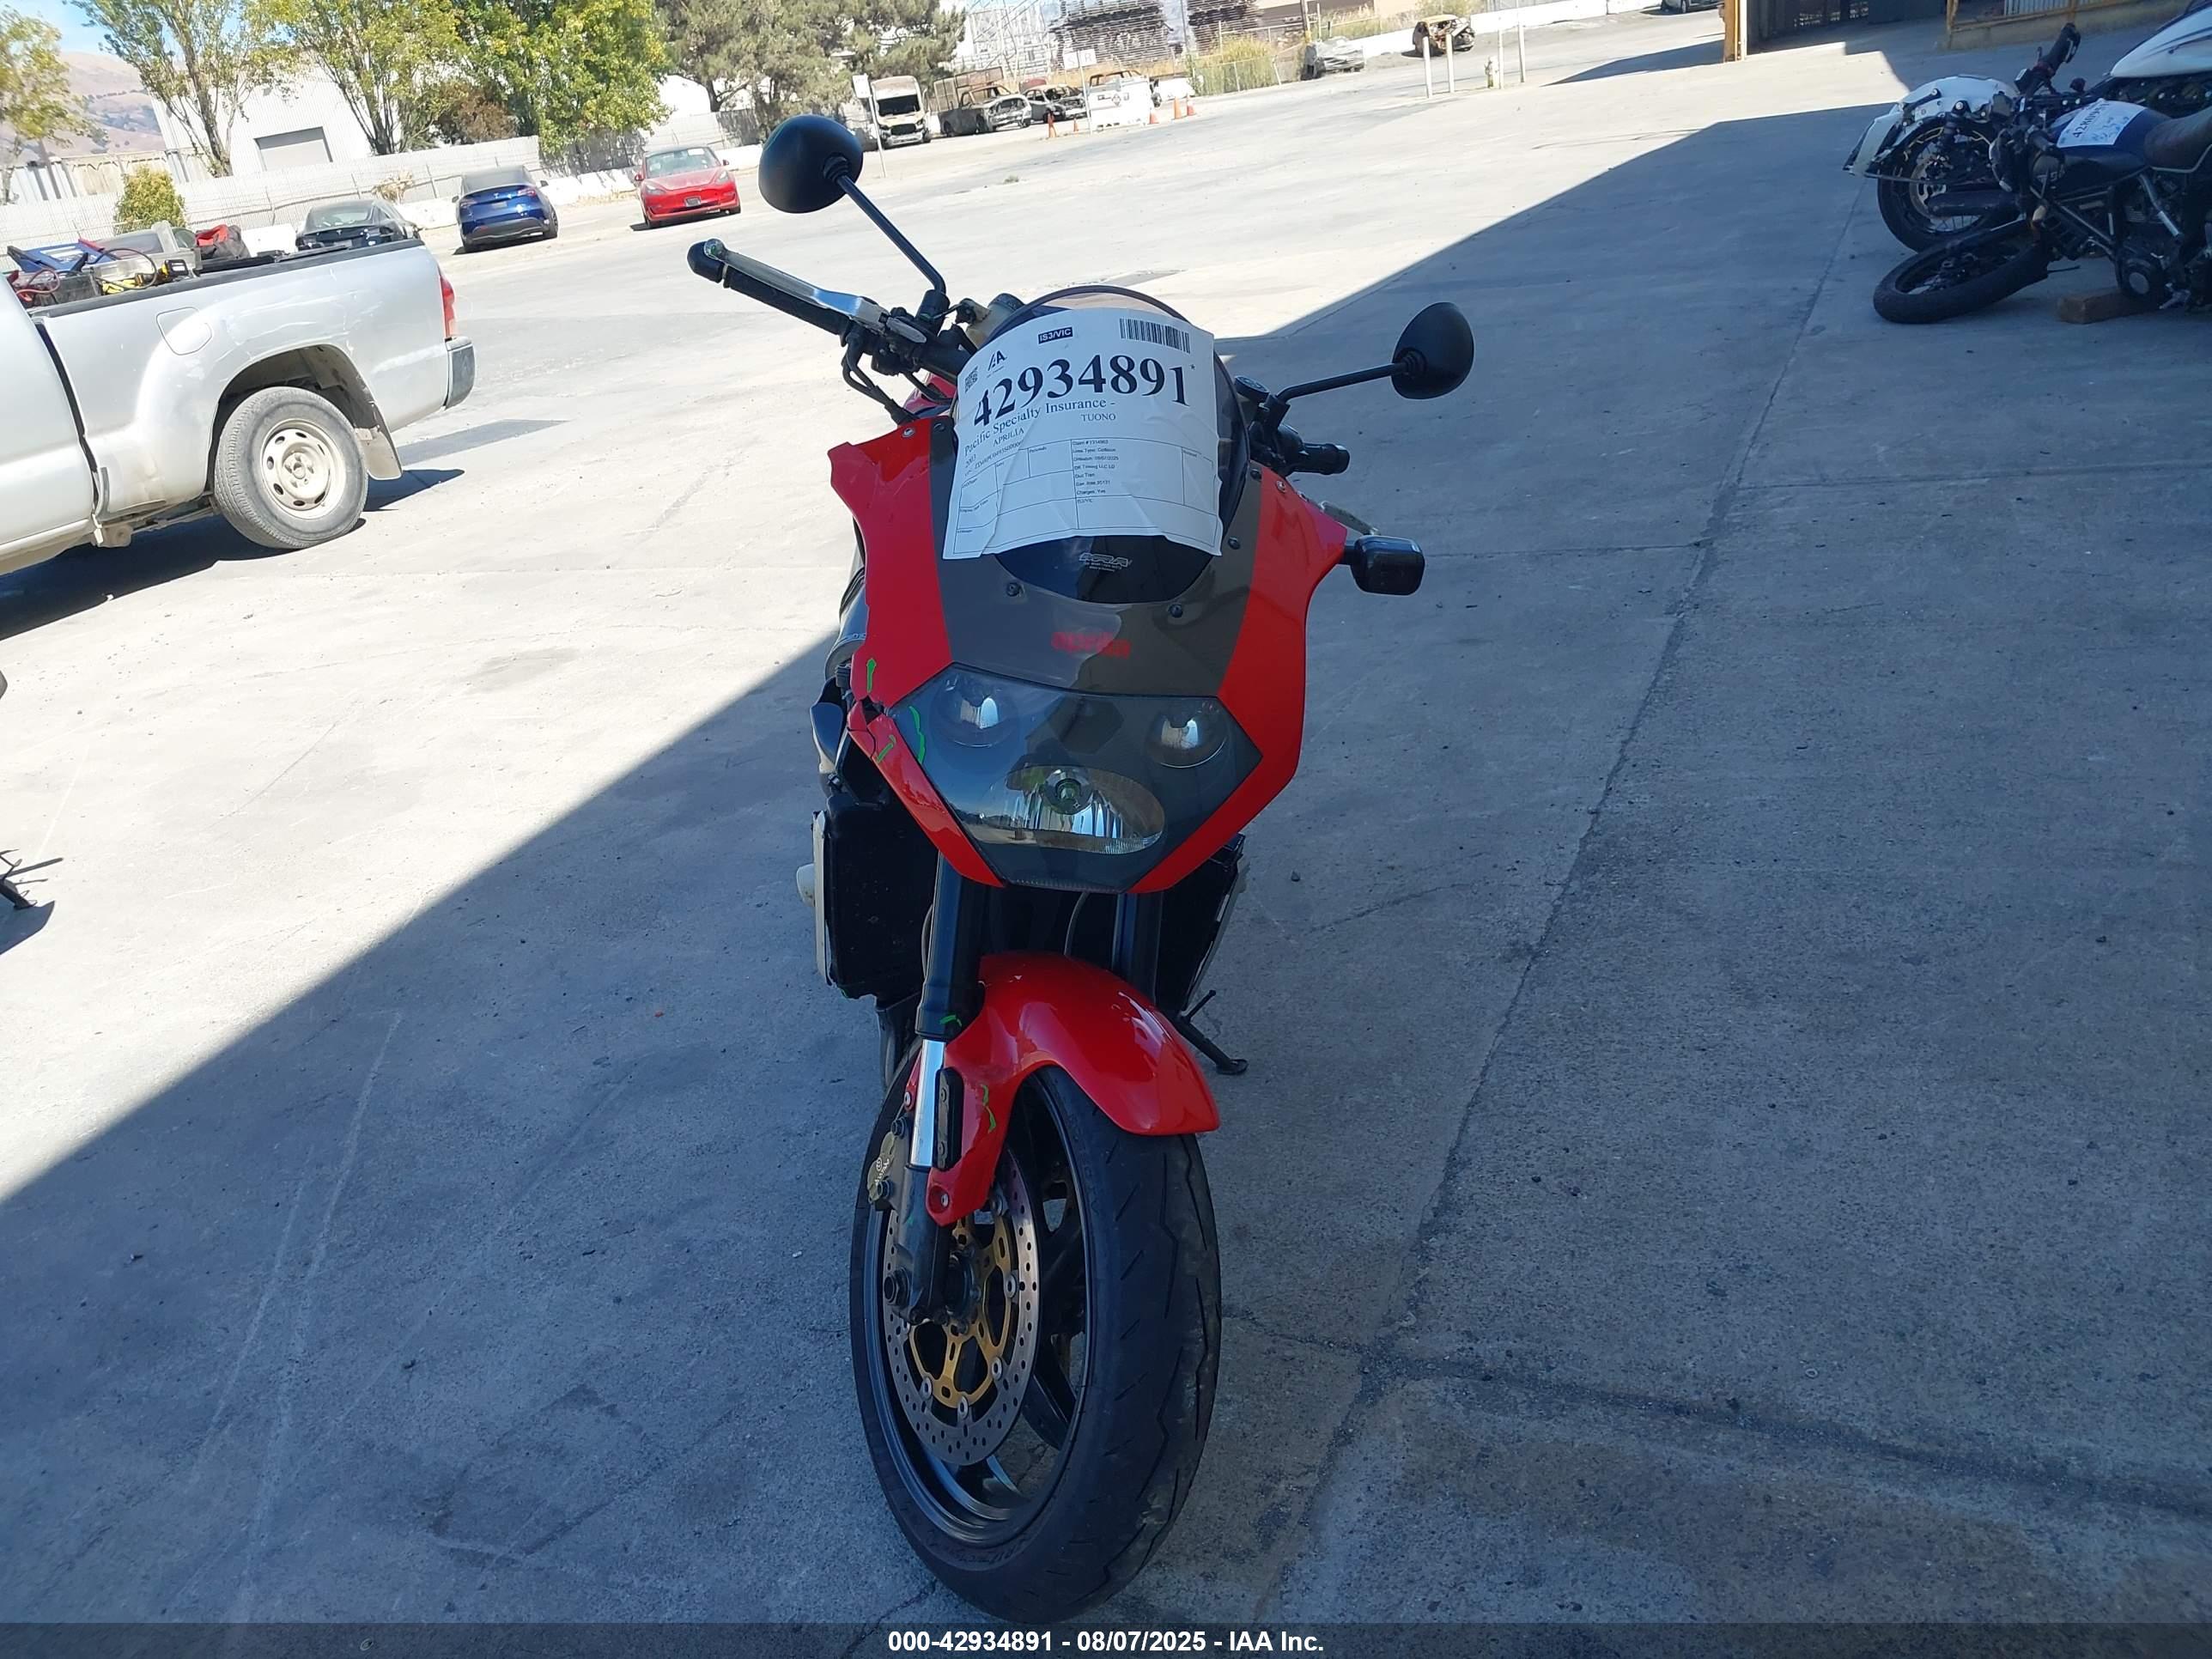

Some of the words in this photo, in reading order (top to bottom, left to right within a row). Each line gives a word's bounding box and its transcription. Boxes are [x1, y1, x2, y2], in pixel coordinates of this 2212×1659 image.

[974, 354, 1190, 426] 42934891
[964, 430, 991, 458] Pacific
[993, 407, 1042, 434] Specialty
[1046, 398, 1107, 414] Insurance
[1081, 413, 1116, 422] TUONO
[994, 428, 1024, 447] APRILIA
